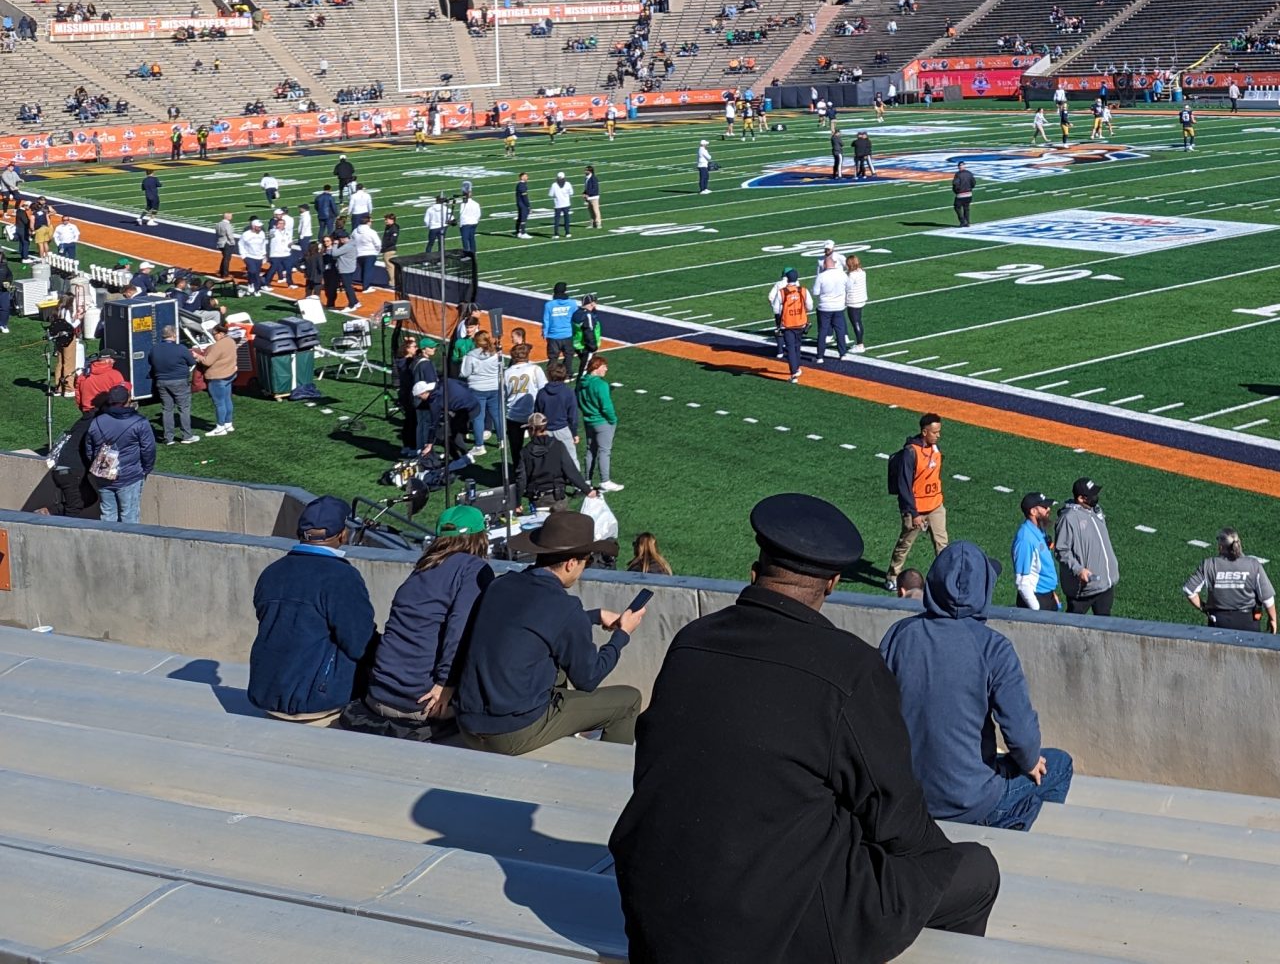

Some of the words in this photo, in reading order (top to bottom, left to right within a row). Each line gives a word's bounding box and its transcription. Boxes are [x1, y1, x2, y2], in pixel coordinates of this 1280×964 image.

[564, 4, 640, 15] MISSIONTIGER.COM
[54, 21, 145, 33] MISSIONTIGER.COM
[761, 240, 872, 257] 30
[953, 263, 1093, 285] 20
[508, 374, 530, 395] 22
[1216, 571, 1250, 581] BEST
